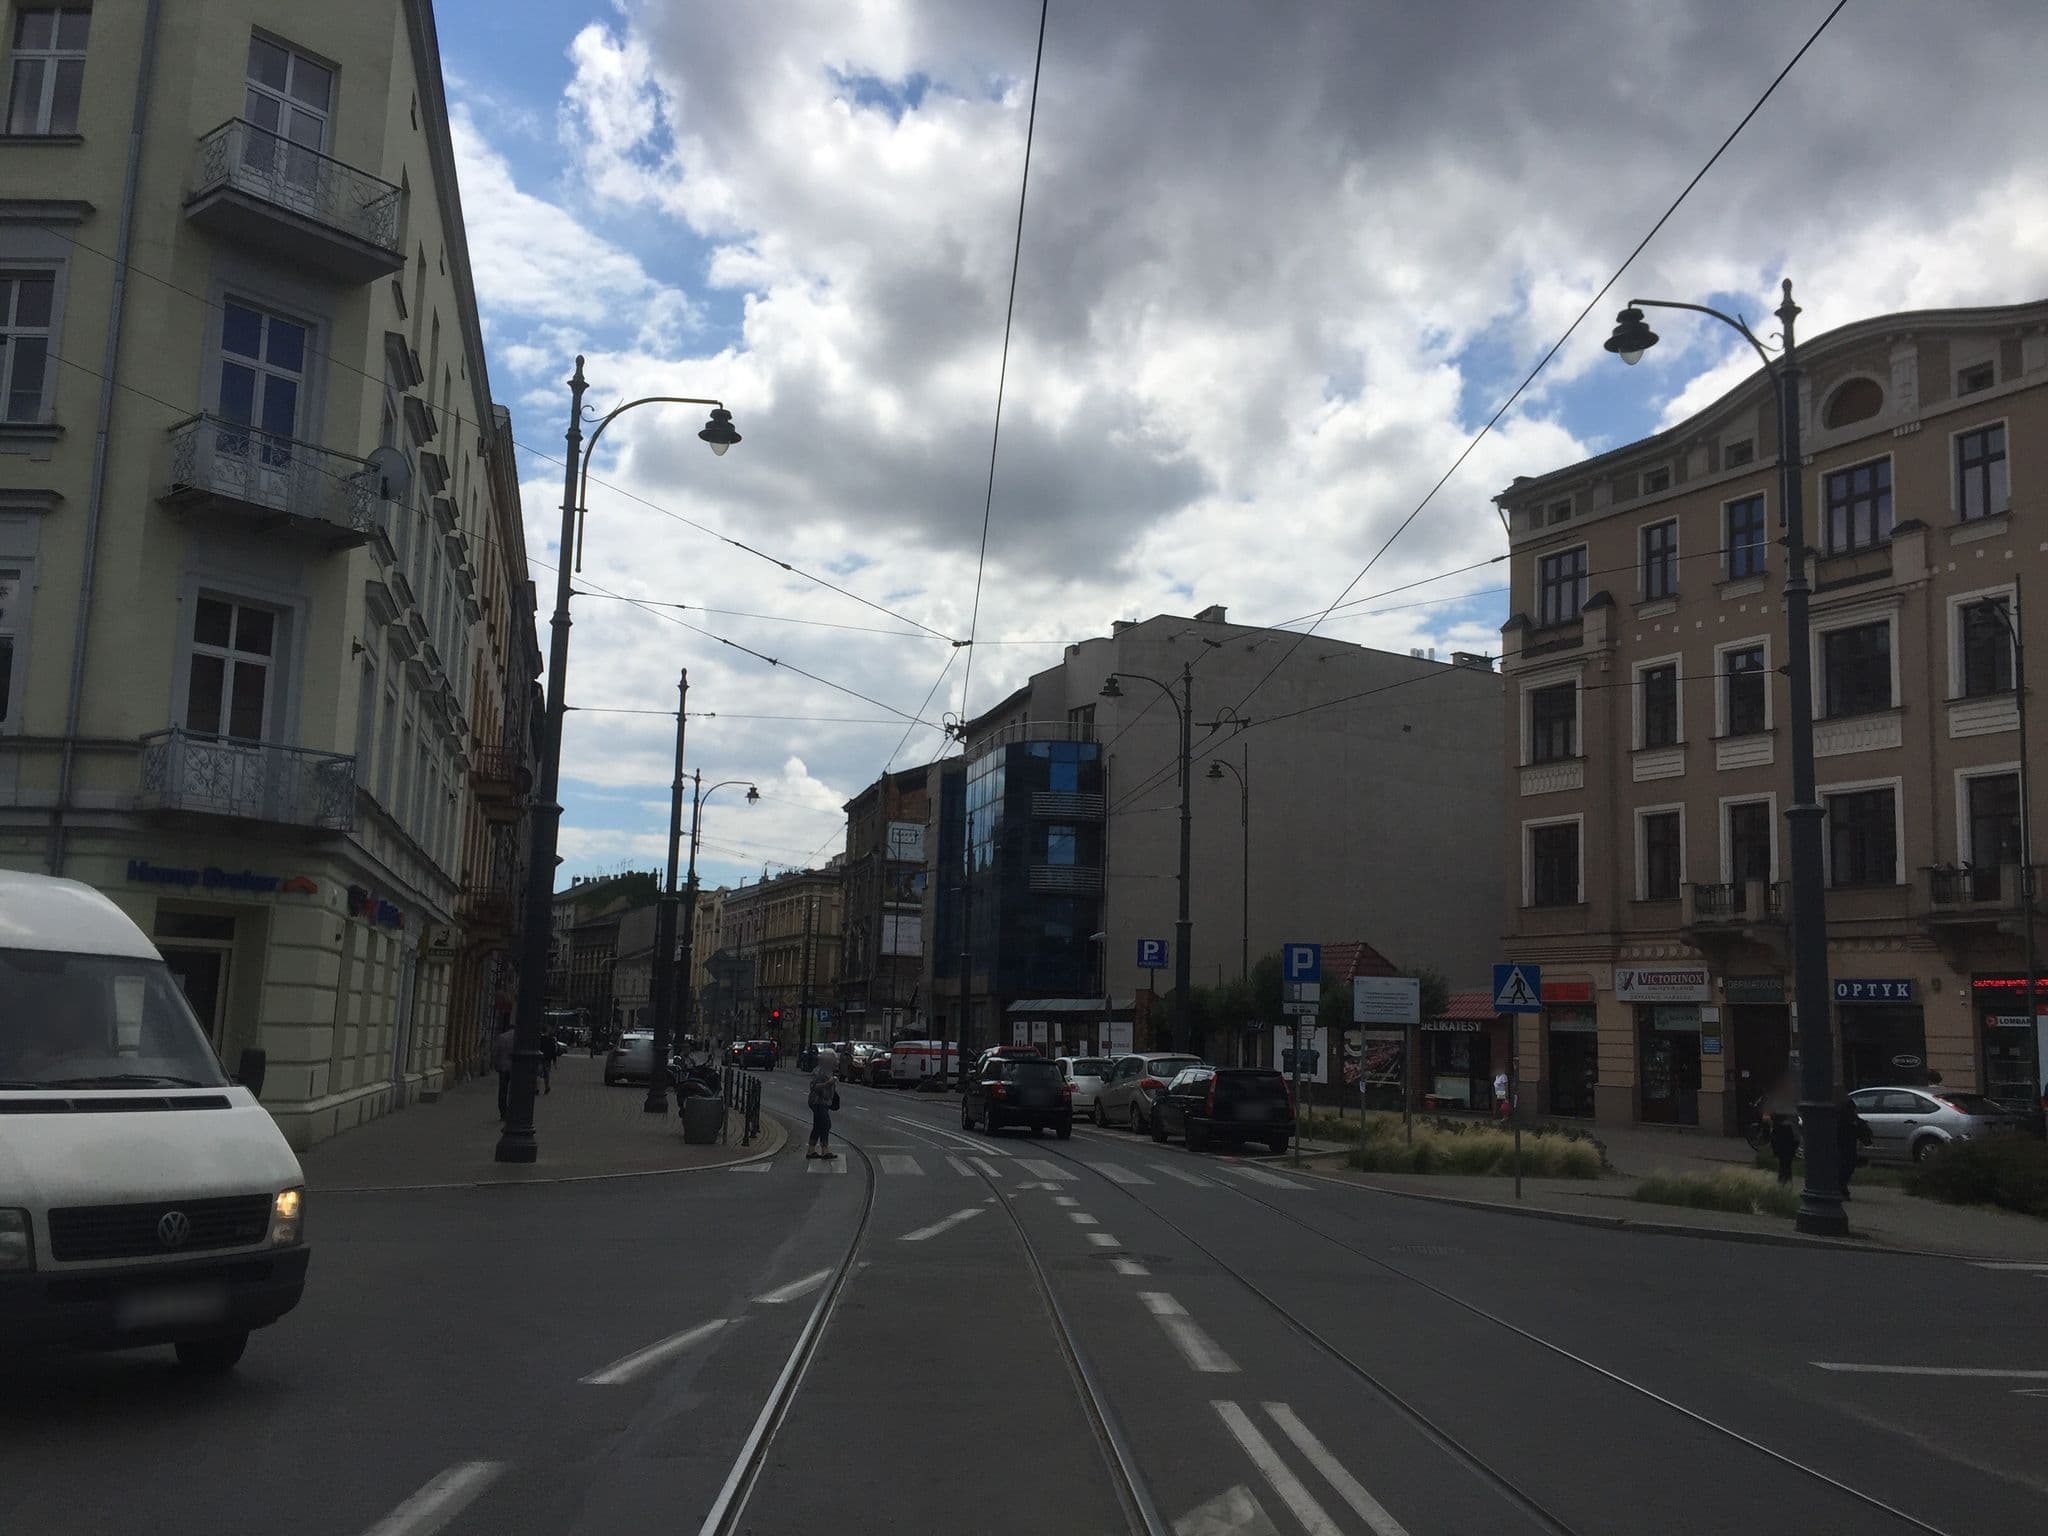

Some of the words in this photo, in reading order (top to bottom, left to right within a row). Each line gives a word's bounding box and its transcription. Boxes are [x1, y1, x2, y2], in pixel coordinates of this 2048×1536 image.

[1144, 941, 1159, 960] P
[1292, 947, 1314, 977] P
[1641, 972, 1703, 984] VICTORINOX
[1837, 983, 1909, 997] OPTYK
[820, 1010, 828, 1021] P
